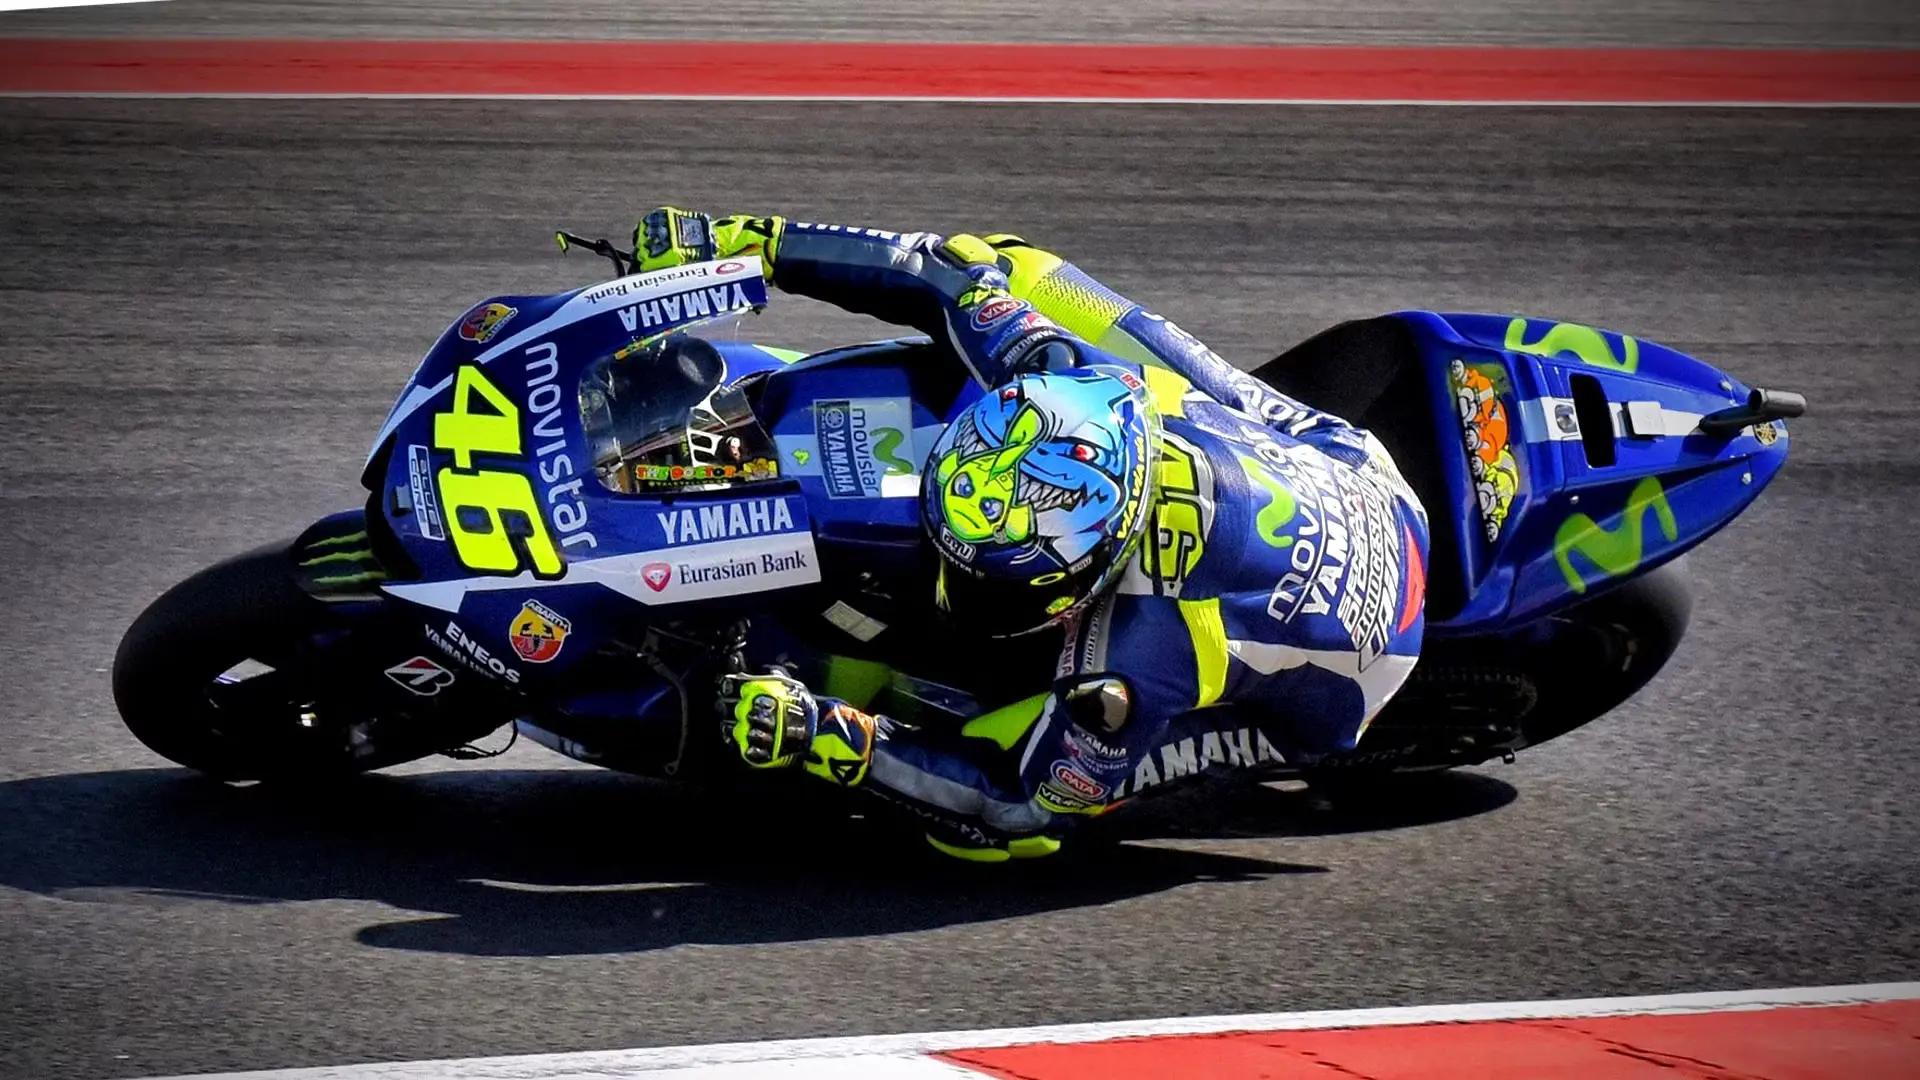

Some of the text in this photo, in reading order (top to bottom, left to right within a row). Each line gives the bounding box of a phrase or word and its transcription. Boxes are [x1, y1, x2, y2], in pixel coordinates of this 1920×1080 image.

[585, 267, 710, 305] Eurasian Bank
[617, 282, 753, 332] YAMAHA
[981, 300, 1019, 320] PATA
[525, 341, 597, 550] movistar
[828, 430, 855, 493] YAMAHA
[852, 408, 879, 491] movistar
[420, 459, 439, 525] BLUE
[433, 364, 566, 578] 46
[656, 498, 794, 545] YAMAHA
[678, 551, 807, 586] Eurasian Bank
[526, 602, 569, 629] ABARTH
[445, 620, 521, 683] ENEOS
[1060, 769, 1095, 796] PATA
